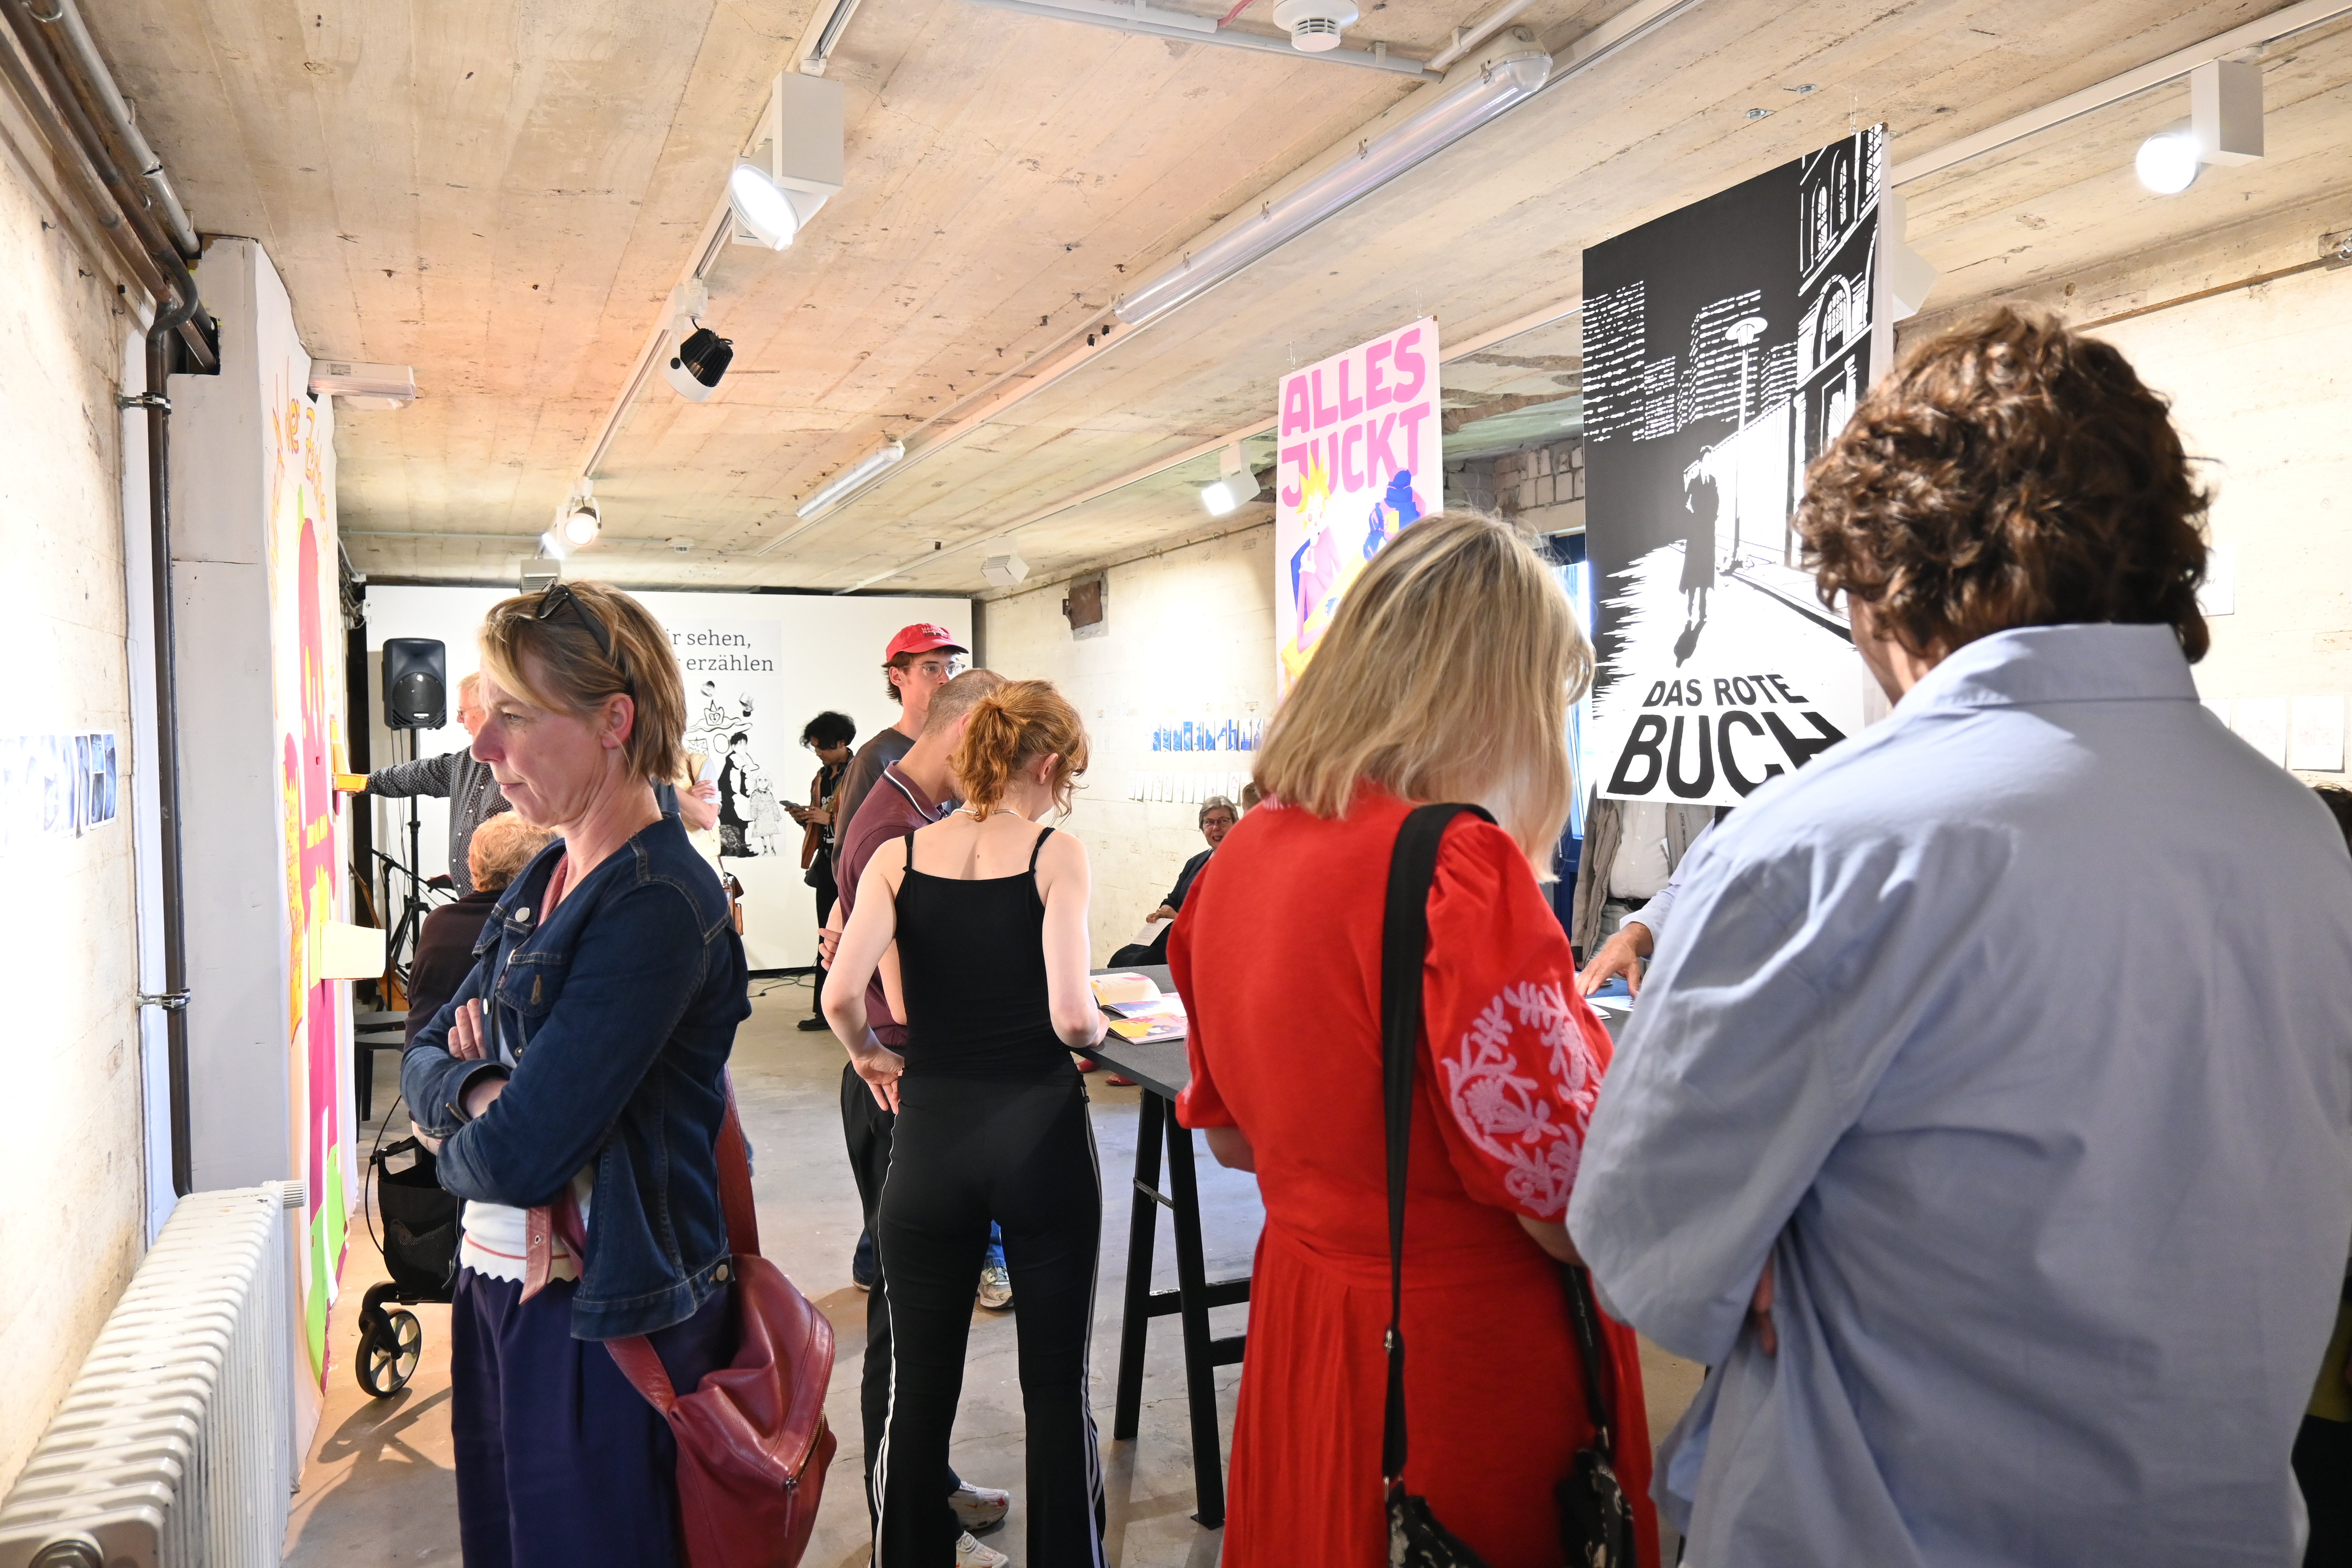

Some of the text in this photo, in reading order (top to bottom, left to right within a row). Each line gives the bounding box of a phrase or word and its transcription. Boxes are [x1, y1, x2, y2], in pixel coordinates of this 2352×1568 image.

[1281, 327, 1426, 437] ALLES
[1281, 401, 1430, 507] JUCKT
[686, 655, 774, 671] erzählen
[687, 629, 751, 649] sehen,
[1642, 674, 1810, 707] DAS ROTE
[1606, 710, 1848, 799] BUCH
